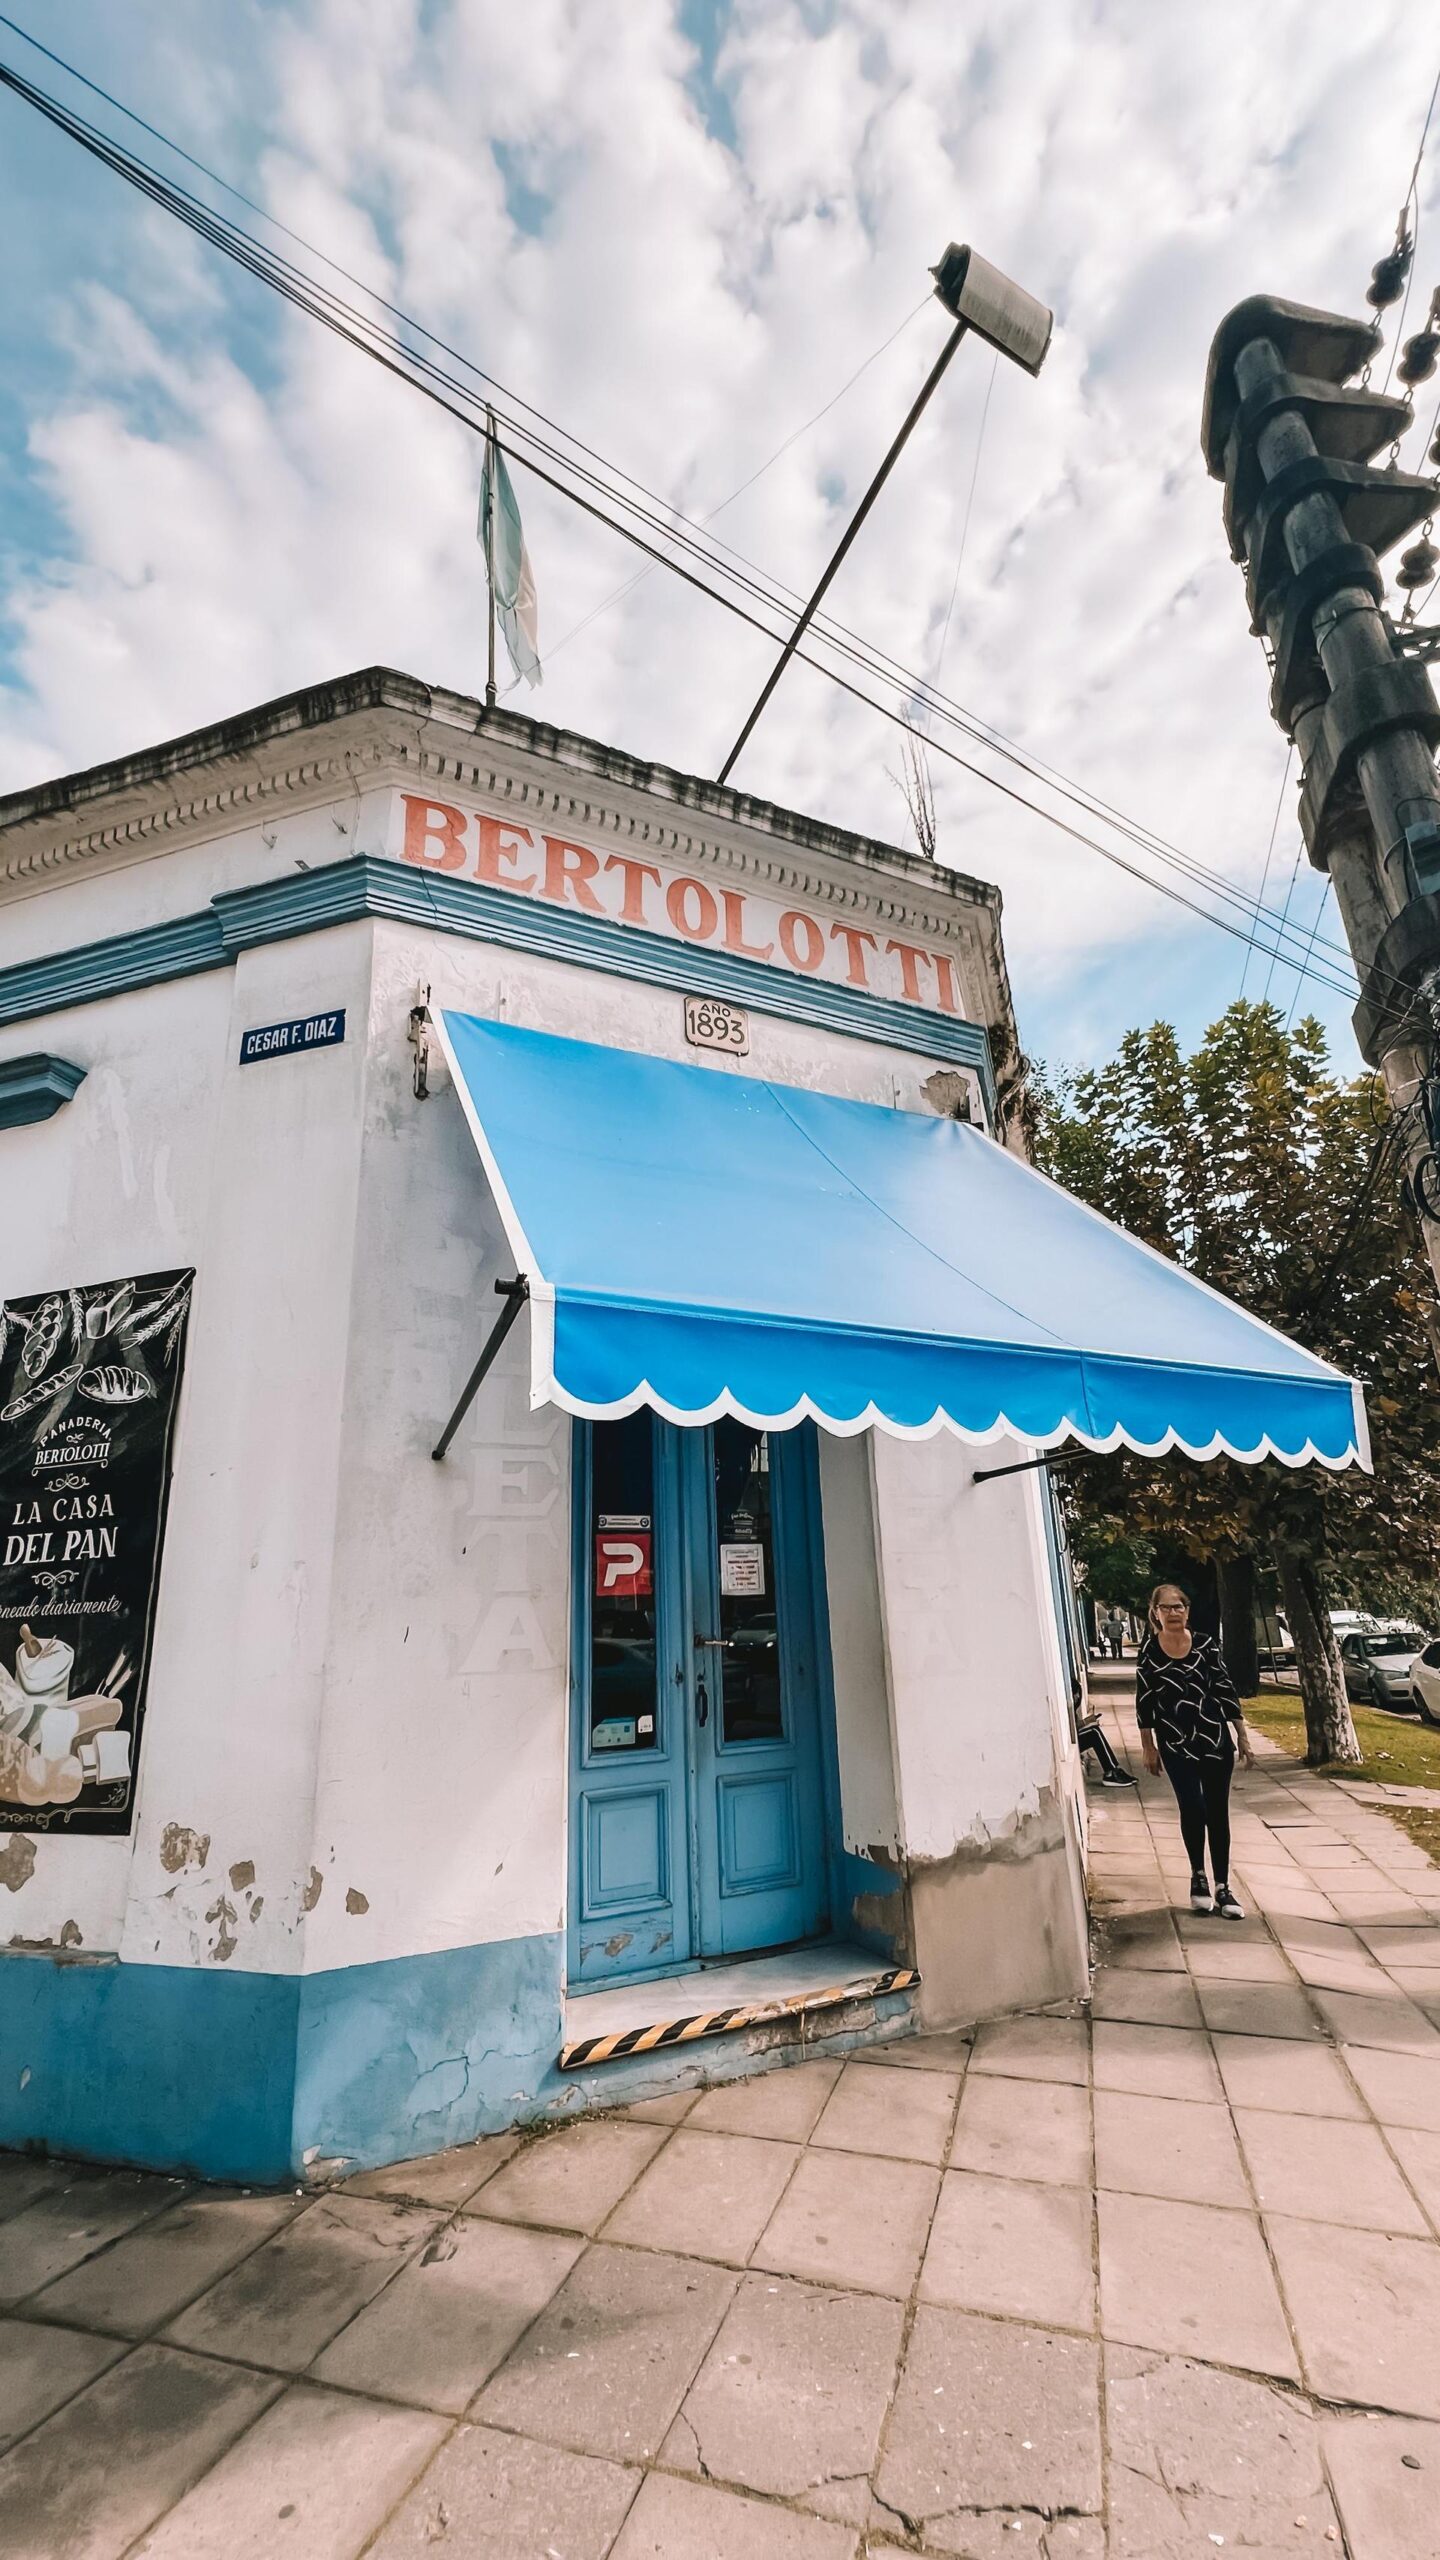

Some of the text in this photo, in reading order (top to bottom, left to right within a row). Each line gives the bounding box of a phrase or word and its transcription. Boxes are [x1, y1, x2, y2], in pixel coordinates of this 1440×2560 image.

[399, 793, 959, 1013] BERTOLOTTI
[700, 1003, 731, 1018] AÑO
[246, 1016, 337, 1055] CESAR F. DIAZ
[688, 1009, 745, 1045] 1893
[39, 1416, 112, 1448] PANADERIA
[34, 1442, 111, 1466] BERTOLOTTI
[12, 1493, 115, 1525] LA CASA
[2, 1526, 119, 1566] DEL PAN
[40, 1594, 121, 1617] diariamente
